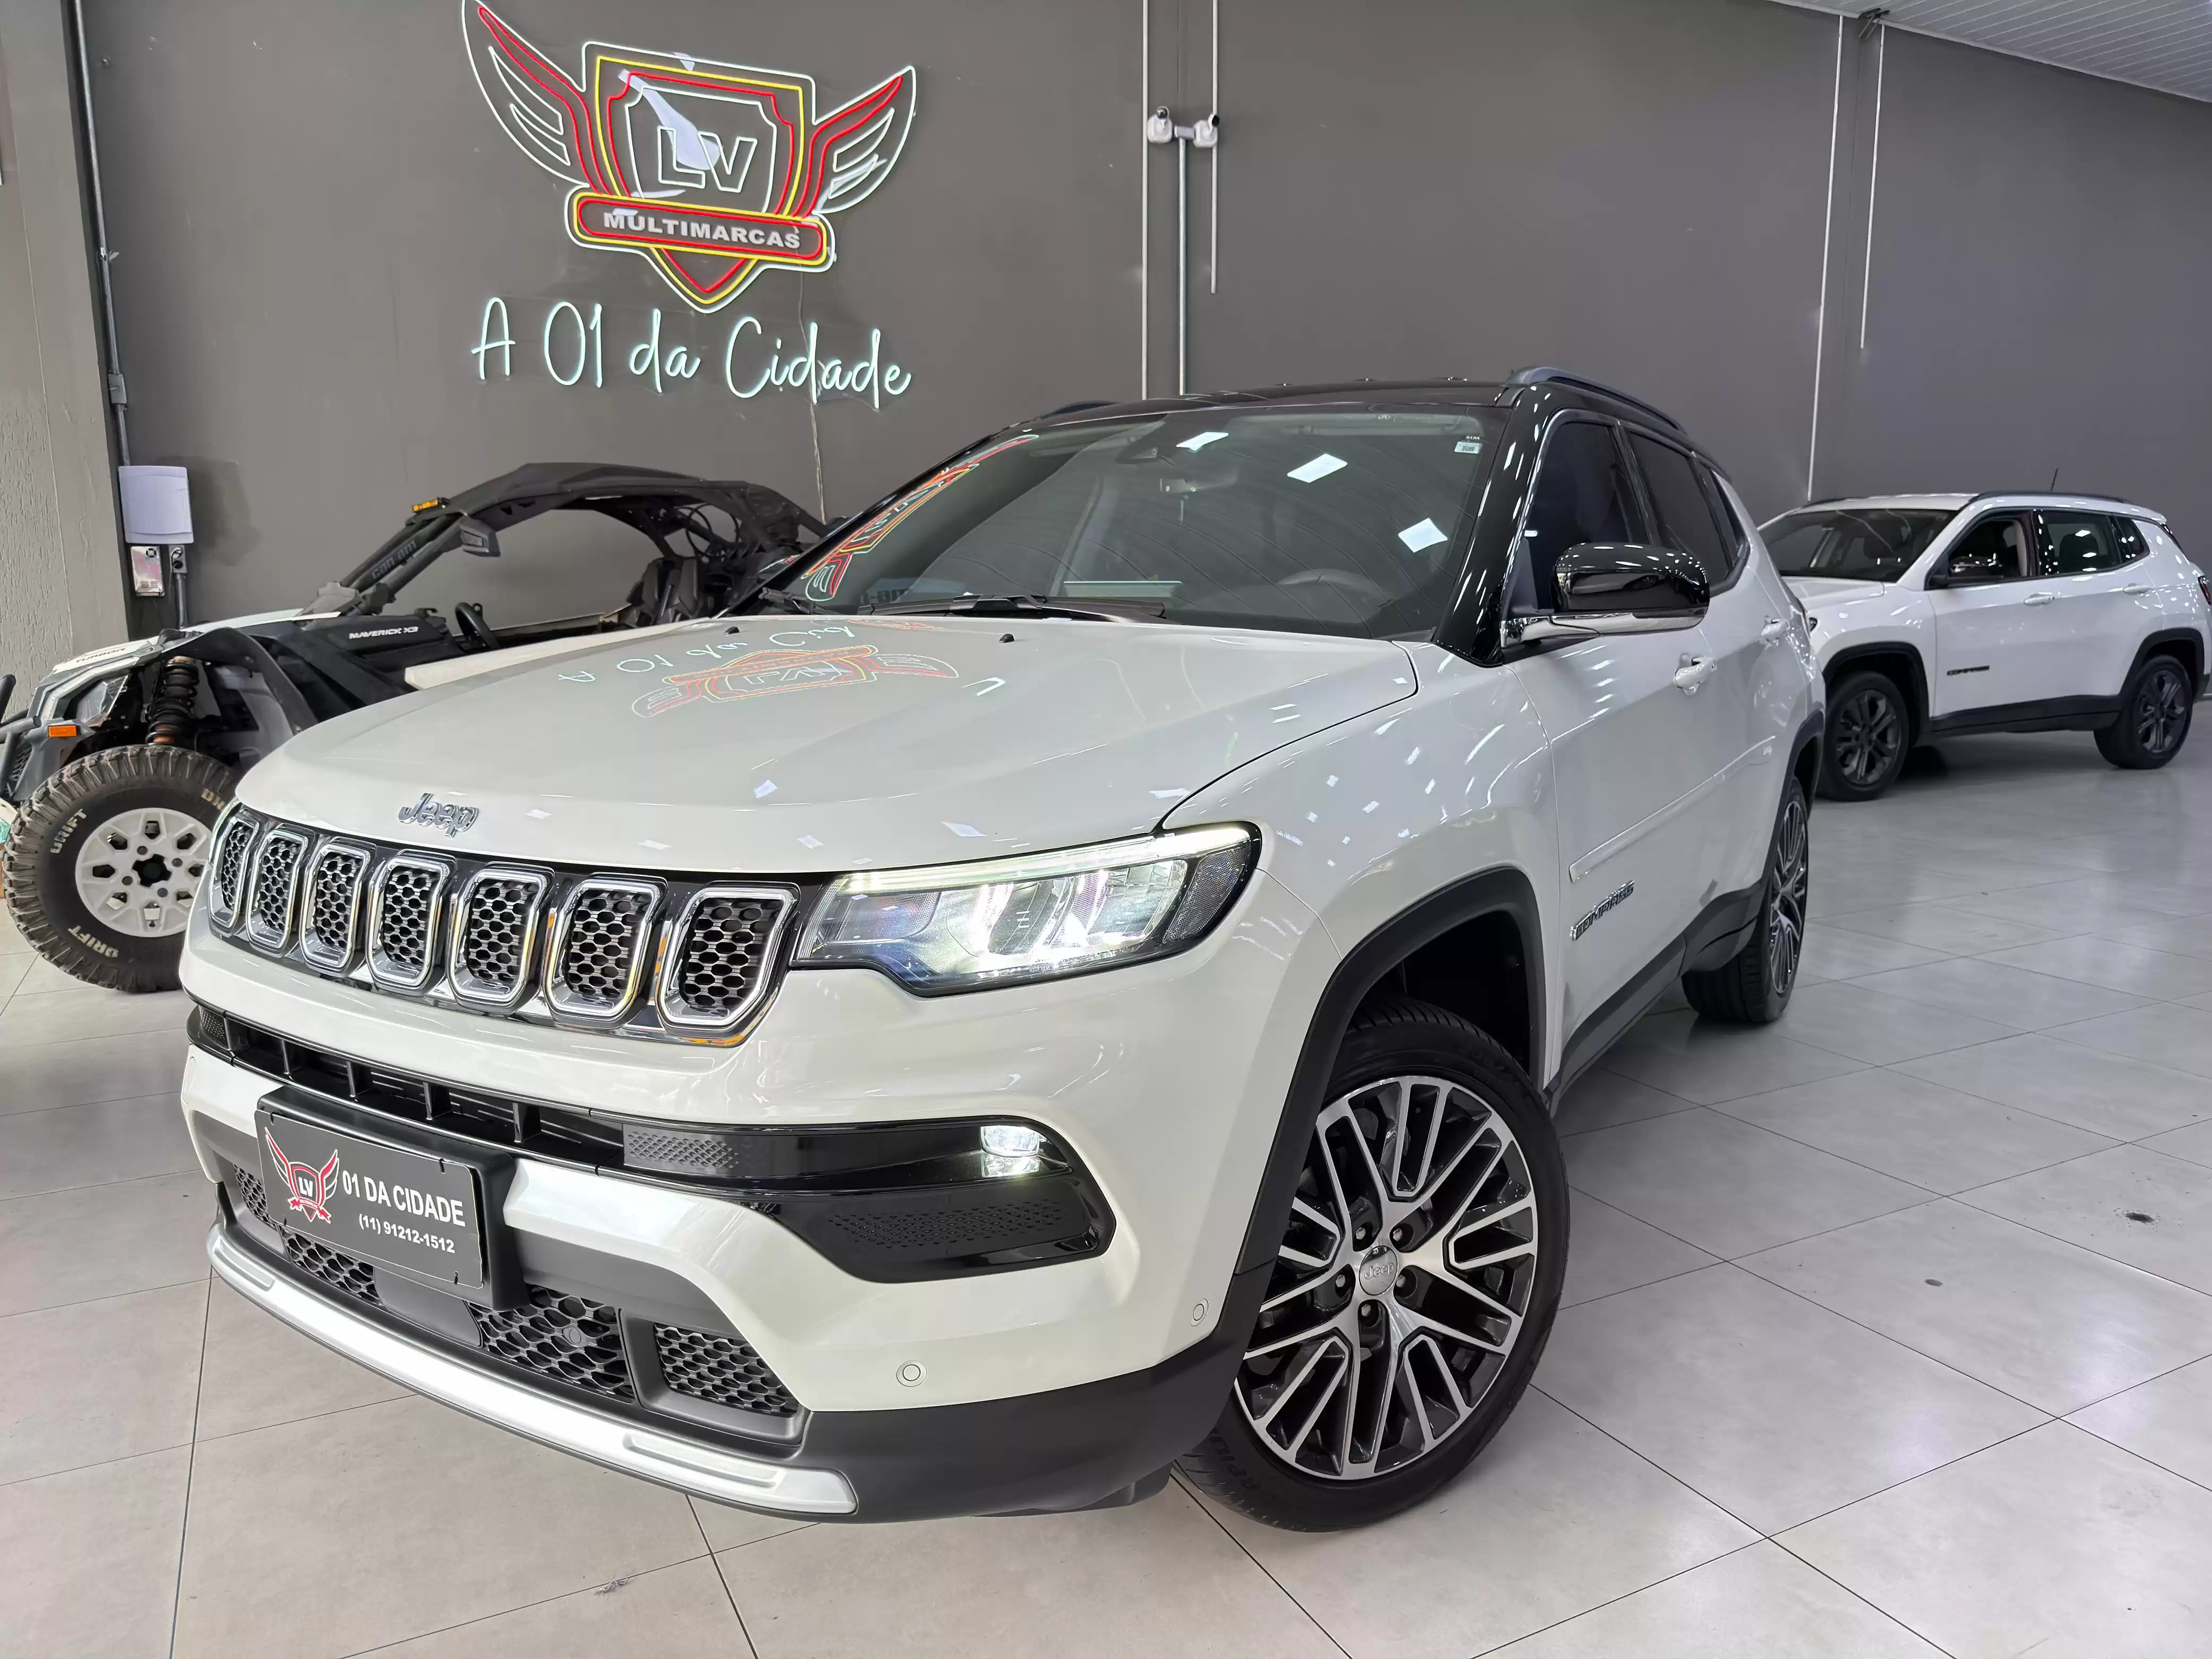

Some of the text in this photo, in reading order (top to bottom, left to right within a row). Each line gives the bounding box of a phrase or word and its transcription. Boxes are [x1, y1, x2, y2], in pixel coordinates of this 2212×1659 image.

[657, 128, 757, 192] LV
[604, 213, 800, 249] MULTIMARCAS
[471, 297, 516, 380] A
[630, 308, 701, 393] da
[726, 317, 911, 408] Cidade
[349, 627, 403, 639] MAVERICK
[50, 808, 87, 853] DRIFT
[398, 792, 480, 838] Jeep
[1570, 880, 1635, 941] COMPASS
[68, 925, 119, 957] DRIFT
[298, 1177, 313, 1197] LV
[342, 1170, 466, 1227] 01 DA CIDADE
[359, 1213, 455, 1253] (11) 91212-1512
[1364, 1262, 1394, 1279] Jeep
